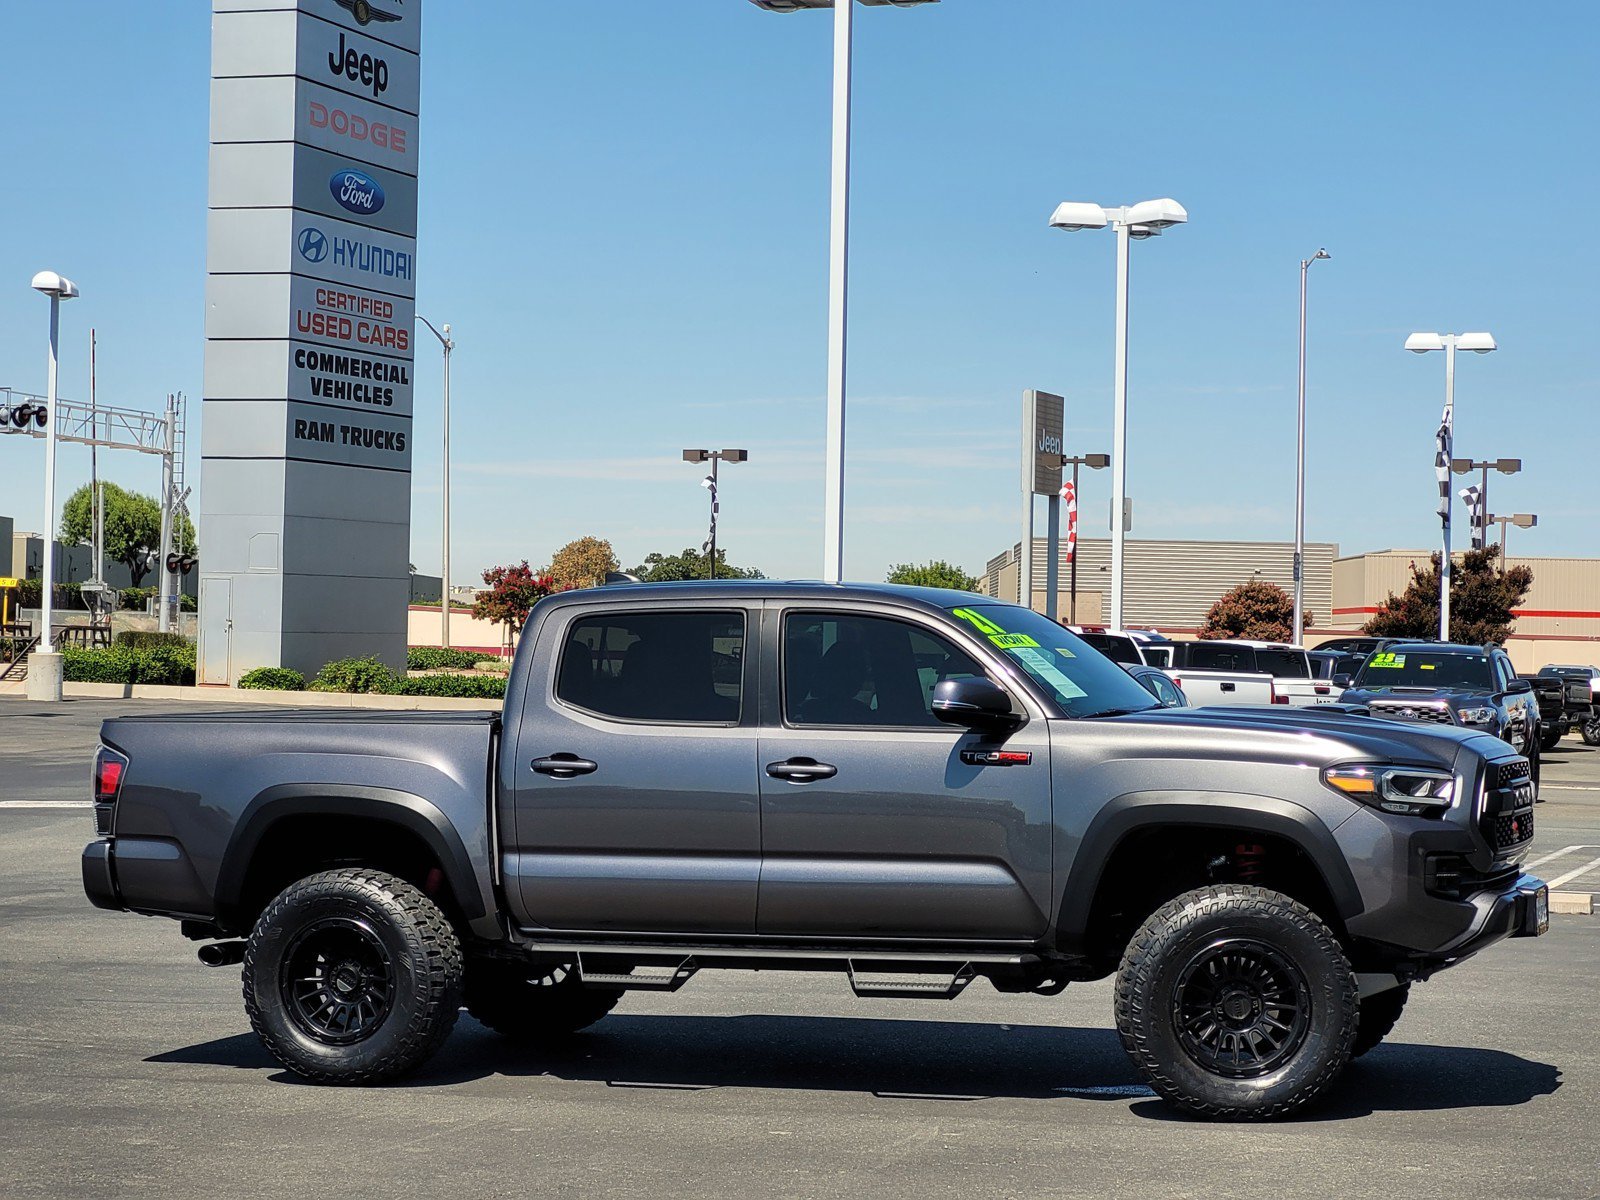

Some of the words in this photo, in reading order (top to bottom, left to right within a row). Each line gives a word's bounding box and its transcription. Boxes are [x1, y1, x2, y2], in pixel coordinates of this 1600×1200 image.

[328, 33, 388, 97] Jeep
[310, 102, 406, 153] DODGE
[340, 174, 374, 209] Ford
[333, 237, 412, 280] HYUNDAI
[316, 289, 392, 318] CERTIFIED
[298, 310, 352, 340] USED
[357, 322, 408, 350] CARS
[294, 349, 408, 384] COMMERCIAL
[310, 377, 393, 406] VEHICLES
[294, 419, 335, 443] RAM
[340, 425, 405, 453] TRUCKS
[1039, 429, 1060, 456] Jeep
[1374, 653, 1396, 663] 23
